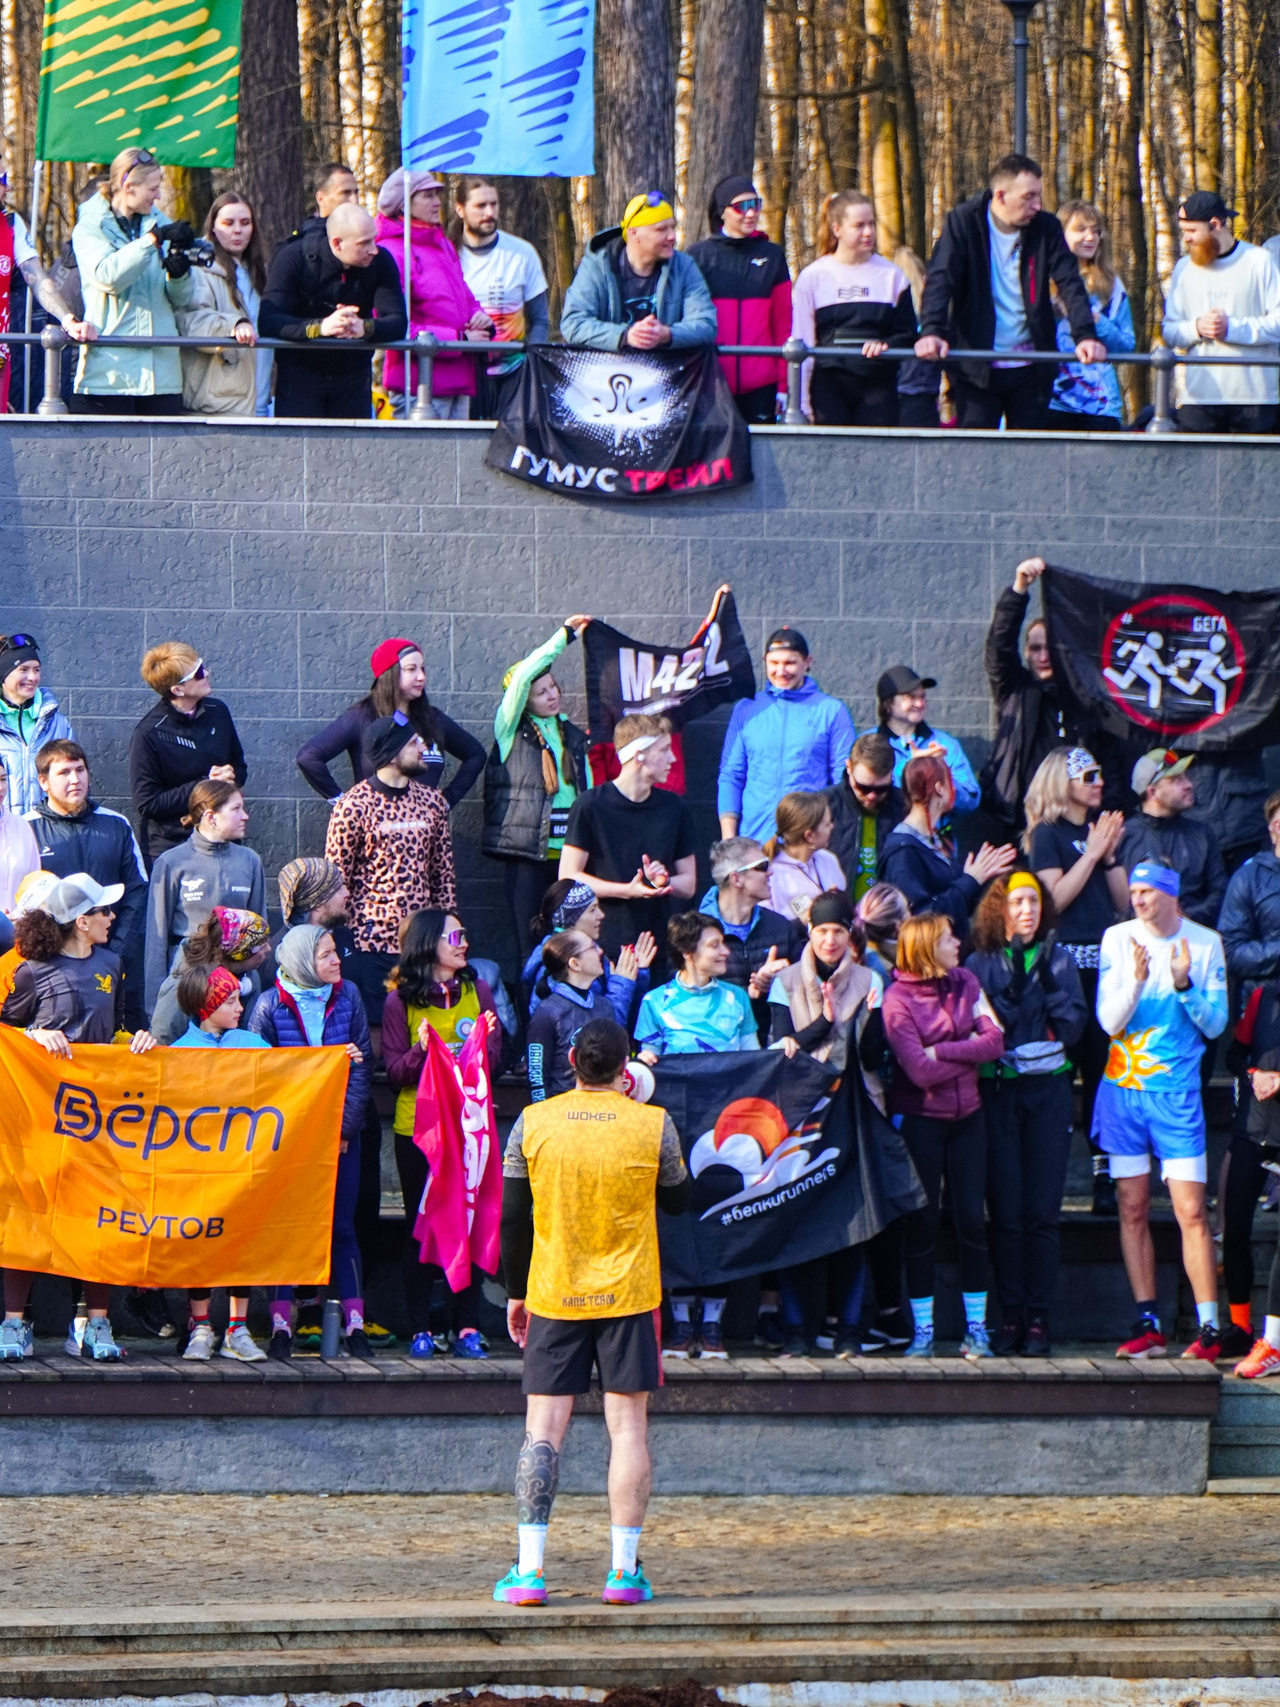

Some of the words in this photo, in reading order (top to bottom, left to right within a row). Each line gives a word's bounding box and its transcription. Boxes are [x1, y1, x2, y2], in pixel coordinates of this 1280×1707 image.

[510, 445, 619, 493] ГУМУС
[624, 457, 734, 493] ТРЕЙЛ
[1192, 615, 1228, 632] БЕГА
[567, 1111, 617, 1122] ШОКЕР
[96, 1206, 225, 1240] РЕУТОВ
